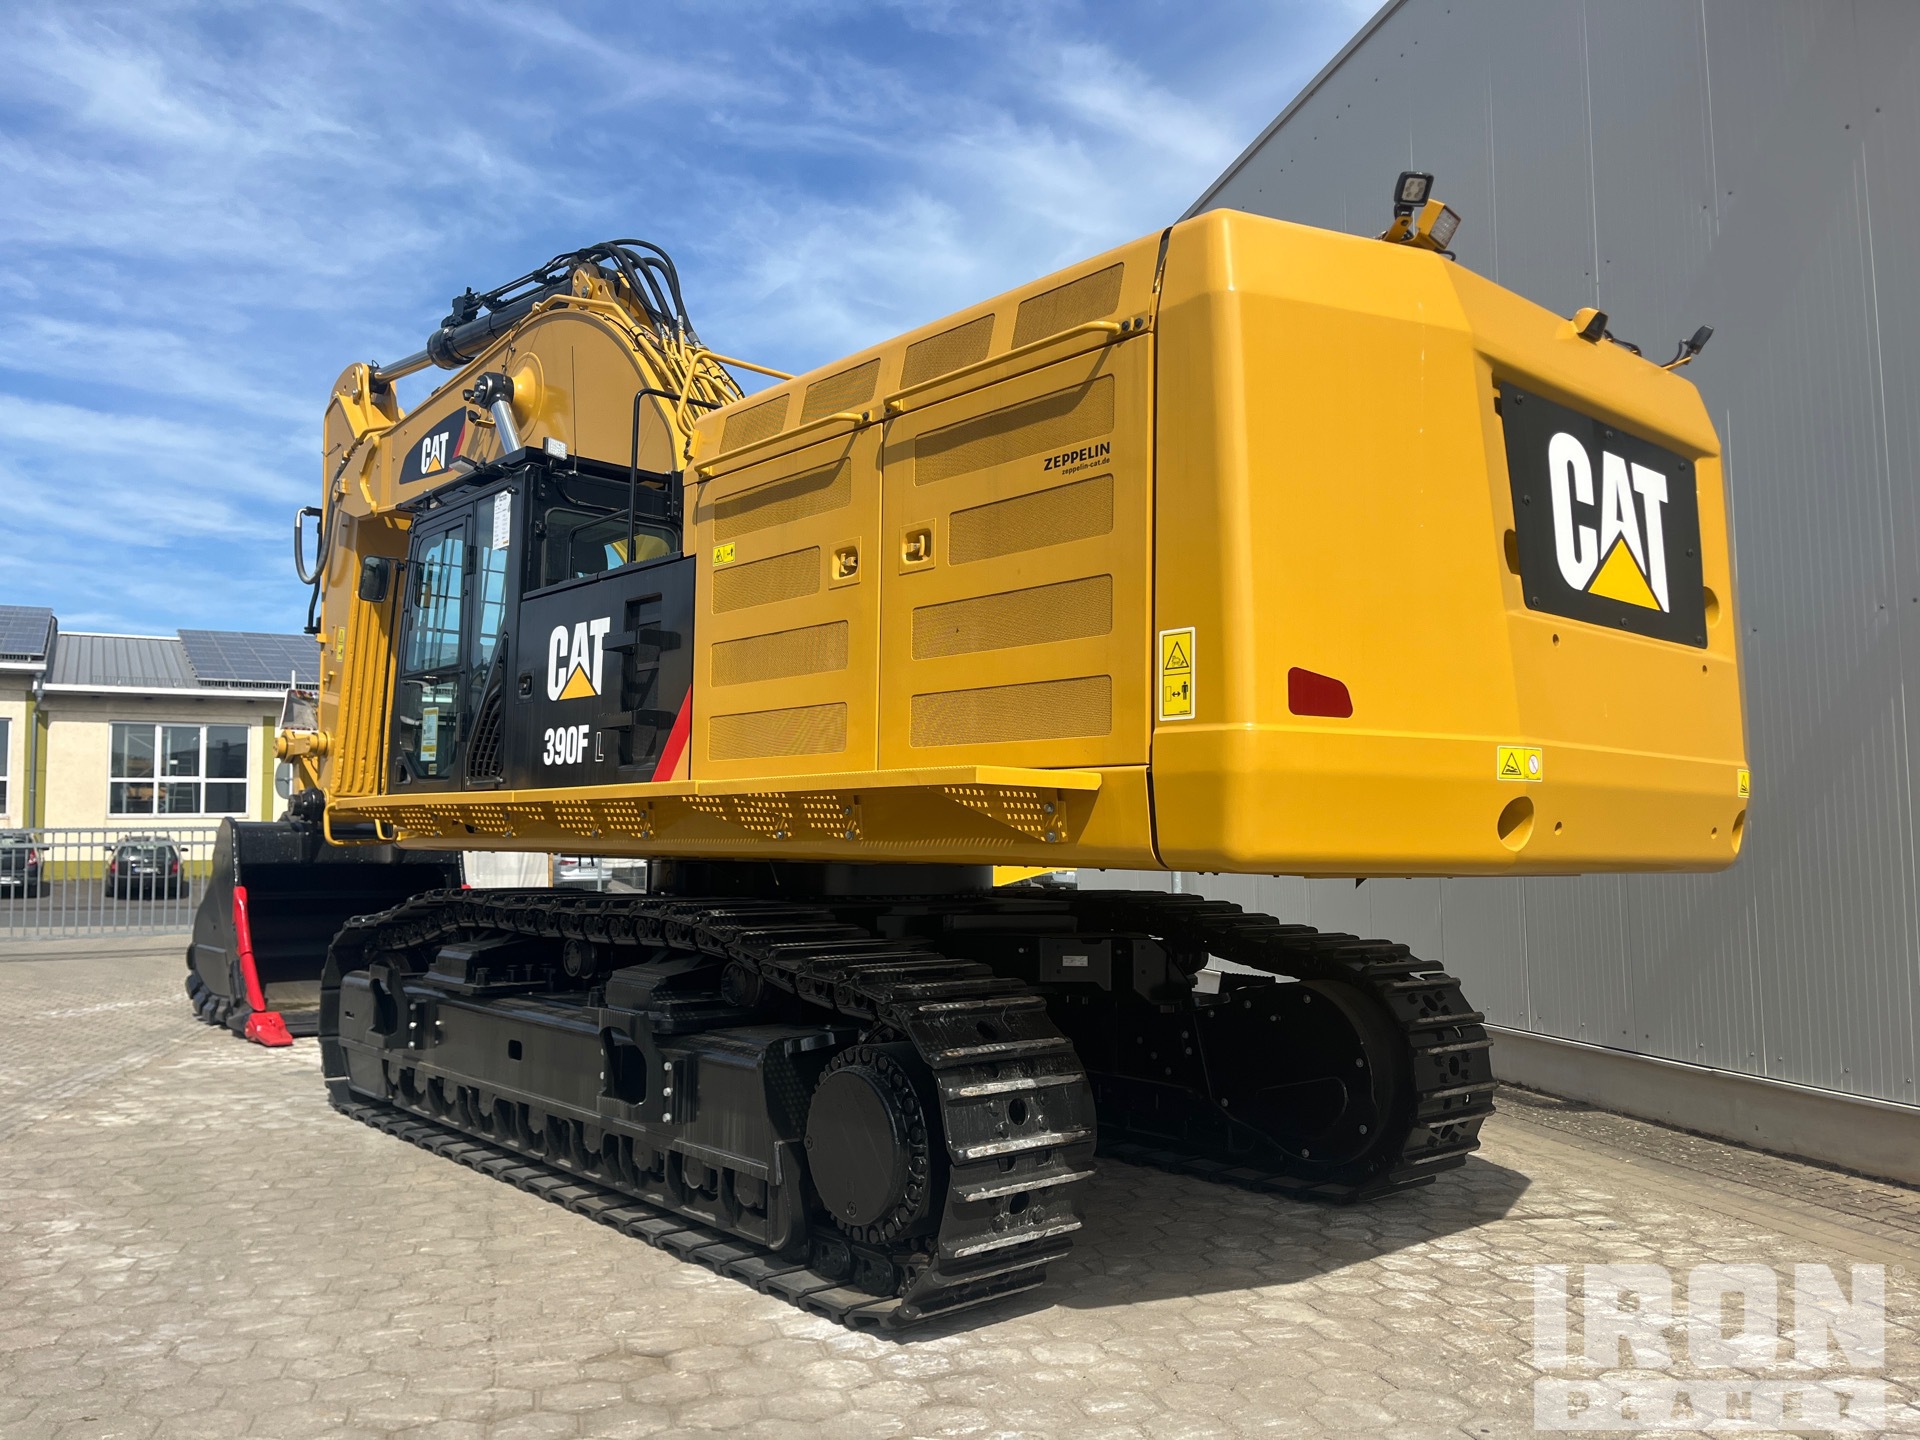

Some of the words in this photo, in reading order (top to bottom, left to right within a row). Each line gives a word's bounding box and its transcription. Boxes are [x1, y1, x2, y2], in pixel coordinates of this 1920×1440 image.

[421, 431, 449, 475] CAT
[1043, 441, 1111, 471] ZEPPELIN
[1061, 457, 1111, 475] zeppelin-cat.de
[1548, 432, 1670, 614] CAT
[547, 616, 611, 702] CAT
[543, 724, 590, 766] 390F
[595, 731, 605, 762] L
